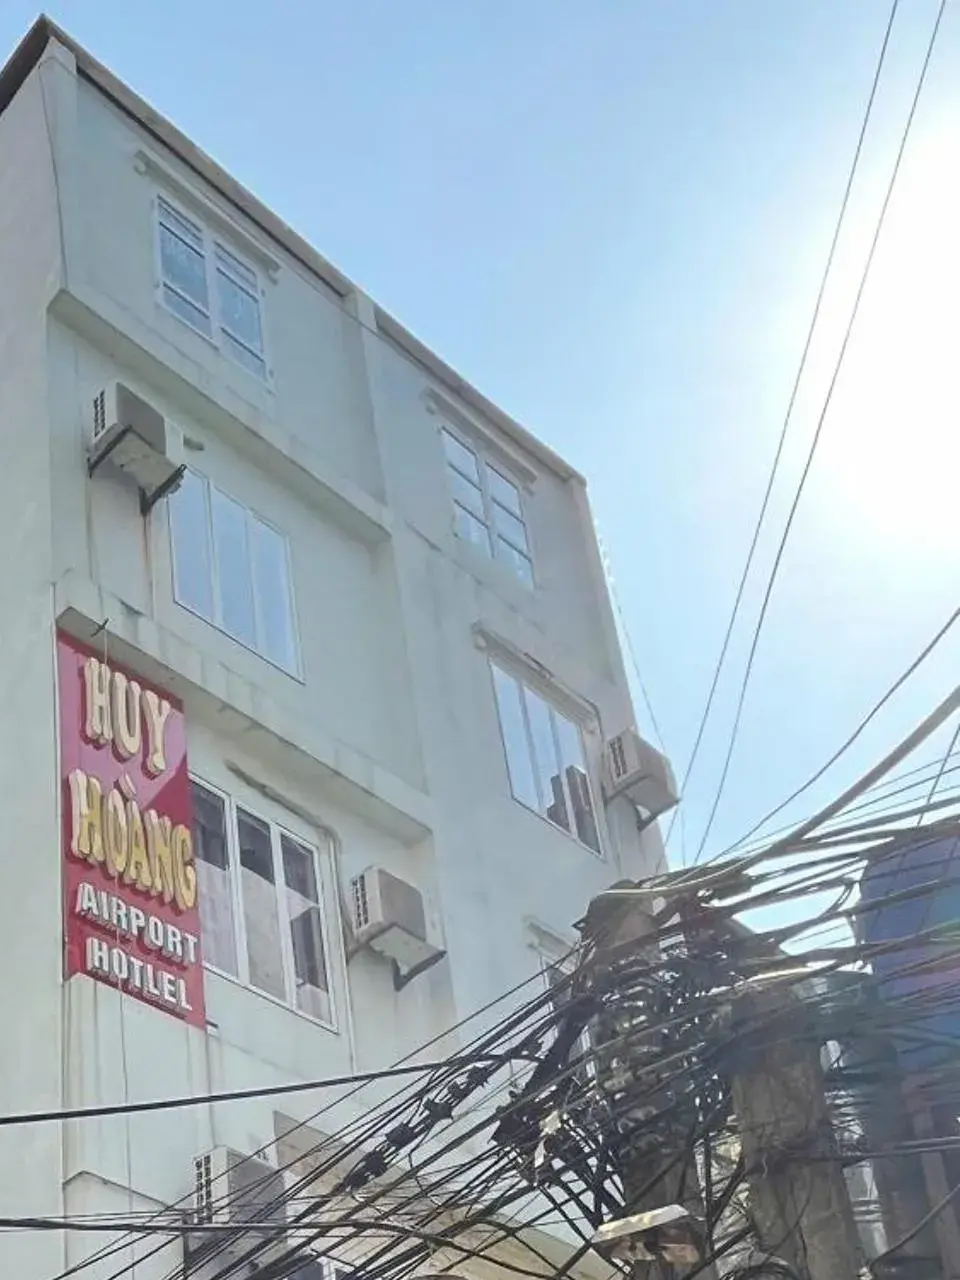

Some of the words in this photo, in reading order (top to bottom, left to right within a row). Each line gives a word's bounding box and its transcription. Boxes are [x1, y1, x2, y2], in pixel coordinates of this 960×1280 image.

[83, 656, 171, 777] HUY
[77, 882, 198, 964] AIRPORT
[86, 936, 193, 1011] HOTLEL
